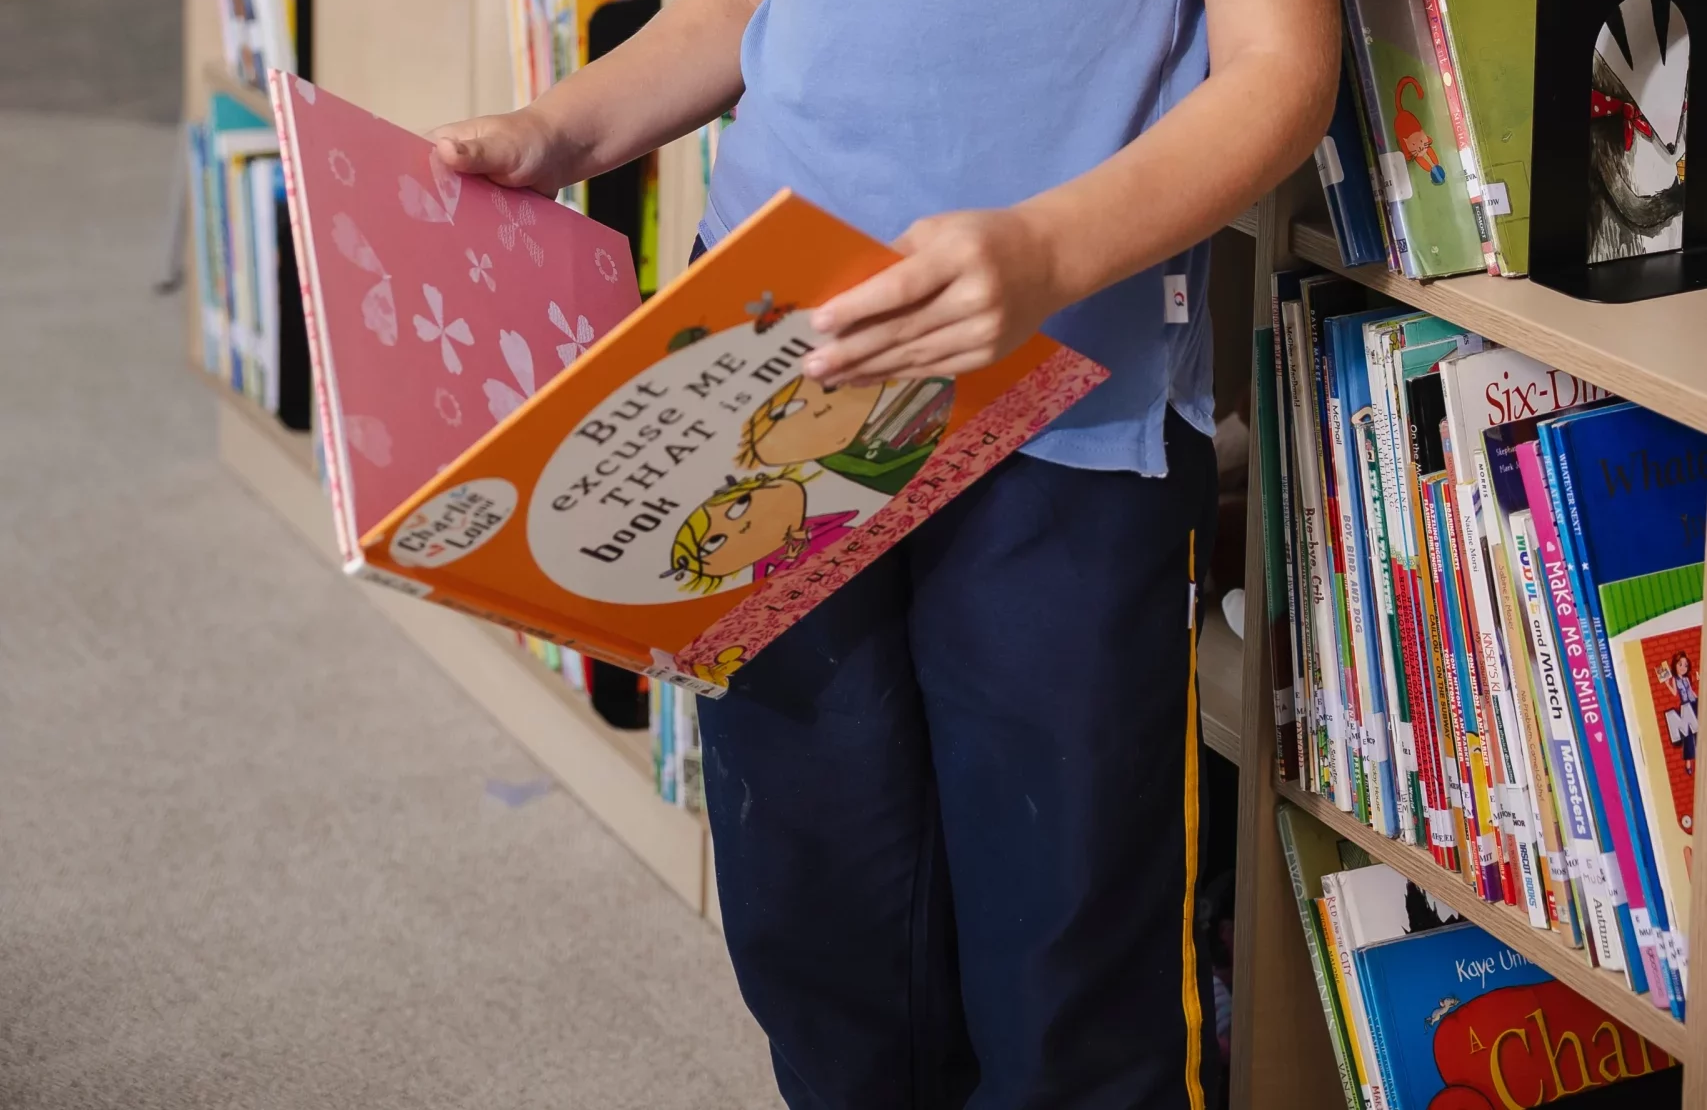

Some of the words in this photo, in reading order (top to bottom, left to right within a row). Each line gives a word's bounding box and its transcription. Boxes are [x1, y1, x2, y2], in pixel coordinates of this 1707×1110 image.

[1475, 205, 1486, 239] EGMONT
[1310, 309, 1318, 343] DAVID
[576, 377, 670, 448] But
[1331, 403, 1343, 445] McPhail
[551, 407, 686, 513] excuse
[684, 352, 748, 401] ME
[599, 420, 718, 510] THAT
[721, 388, 753, 415] is
[1409, 424, 1418, 440] On
[1373, 403, 1381, 441] DAVID
[1378, 447, 1389, 502] MELLING
[1378, 409, 1386, 446] DAVID
[1383, 453, 1394, 508] MELLING
[1384, 414, 1392, 451] DAVID
[1389, 458, 1400, 513] MELLING
[1392, 413, 1400, 450] DAVID
[1397, 457, 1408, 512] MELLING
[1499, 463, 1514, 473] Mark
[1478, 463, 1488, 498] MORRIS
[1544, 454, 1554, 485] PEACE
[1550, 487, 1557, 500] AT
[1554, 502, 1564, 524] LAST
[1559, 453, 1576, 508] WHATEVER
[1571, 508, 1582, 535] NEXT!
[397, 493, 482, 552] Charlie
[444, 512, 502, 549] Lola
[580, 496, 681, 565] book
[764, 523, 886, 617] lauren
[908, 431, 999, 506] child
[1304, 508, 1319, 570] Bye-bye,
[1343, 514, 1352, 541] BOY,
[1422, 498, 1432, 532] FLASHING
[1431, 552, 1440, 582] ENGINES
[1428, 502, 1439, 540] DAZZLING
[1434, 542, 1444, 572] DIGGERS
[1444, 502, 1455, 536] ROARING
[1450, 538, 1461, 570] ROCKETS
[1378, 538, 1387, 560] TO
[1464, 515, 1474, 546] Nadine
[1470, 548, 1479, 572] Morsi
[1311, 575, 1324, 605] Crib
[1350, 582, 1359, 604] AND
[1381, 561, 1395, 615] LISTEN
[1498, 565, 1506, 594] Sabine
[1506, 605, 1514, 630] Moser
[1353, 607, 1363, 634] DOG
[1399, 614, 1408, 640] LOVE
[1475, 632, 1481, 644] My
[1534, 620, 1547, 647] and
[1399, 576, 1411, 624] HUGLESS
[1406, 626, 1418, 676] DOUGLAS
[1413, 680, 1422, 706] GOES
[1402, 644, 1411, 666] YOU
[1482, 632, 1499, 678] KINSEY'S
[1561, 626, 1582, 657] Me
[1579, 618, 1589, 637] JILL
[1585, 639, 1599, 679] MURPHY
[1593, 616, 1602, 636] JILL
[1598, 637, 1613, 678] MURPHY
[1429, 614, 1438, 653] CAILLOU
[1436, 665, 1442, 677] ON
[1440, 700, 1450, 739] SUBWAY
[1448, 652, 1456, 674] TONY
[1466, 652, 1475, 674] TONY
[1452, 676, 1461, 706] MITTON
[1470, 676, 1480, 706] MITTON
[1521, 690, 1526, 699] No
[1540, 652, 1562, 720] Match
[1442, 648, 1450, 670] TONY
[1446, 670, 1455, 700] MITTON
[1455, 730, 1465, 762] PARKER
[1477, 714, 1485, 732] ANT
[1522, 702, 1532, 740] Problem,
[1458, 716, 1466, 732] ANT
[1498, 729, 1507, 752] physical
[1330, 749, 1338, 785] Schuster
[1461, 734, 1471, 766] PARKER
[1481, 734, 1491, 766] PARKER
[1353, 757, 1361, 784] PRESS
[1560, 745, 1587, 835] Monsters
[1480, 853, 1493, 862] MIT
[1525, 877, 1537, 908] BOOKS
[1286, 846, 1304, 900] TWO
[1300, 910, 1319, 958] BAD
[1314, 970, 1336, 1031] ANTS
[1592, 898, 1611, 959] Autumn
[1340, 951, 1352, 977] CITY
[1455, 955, 1496, 989] Kaye
[1468, 1026, 1487, 1055] A
[1338, 1063, 1350, 1090] VAN
[1376, 1024, 1388, 1055] CHAIR
[1388, 1078, 1397, 1102] BABY
